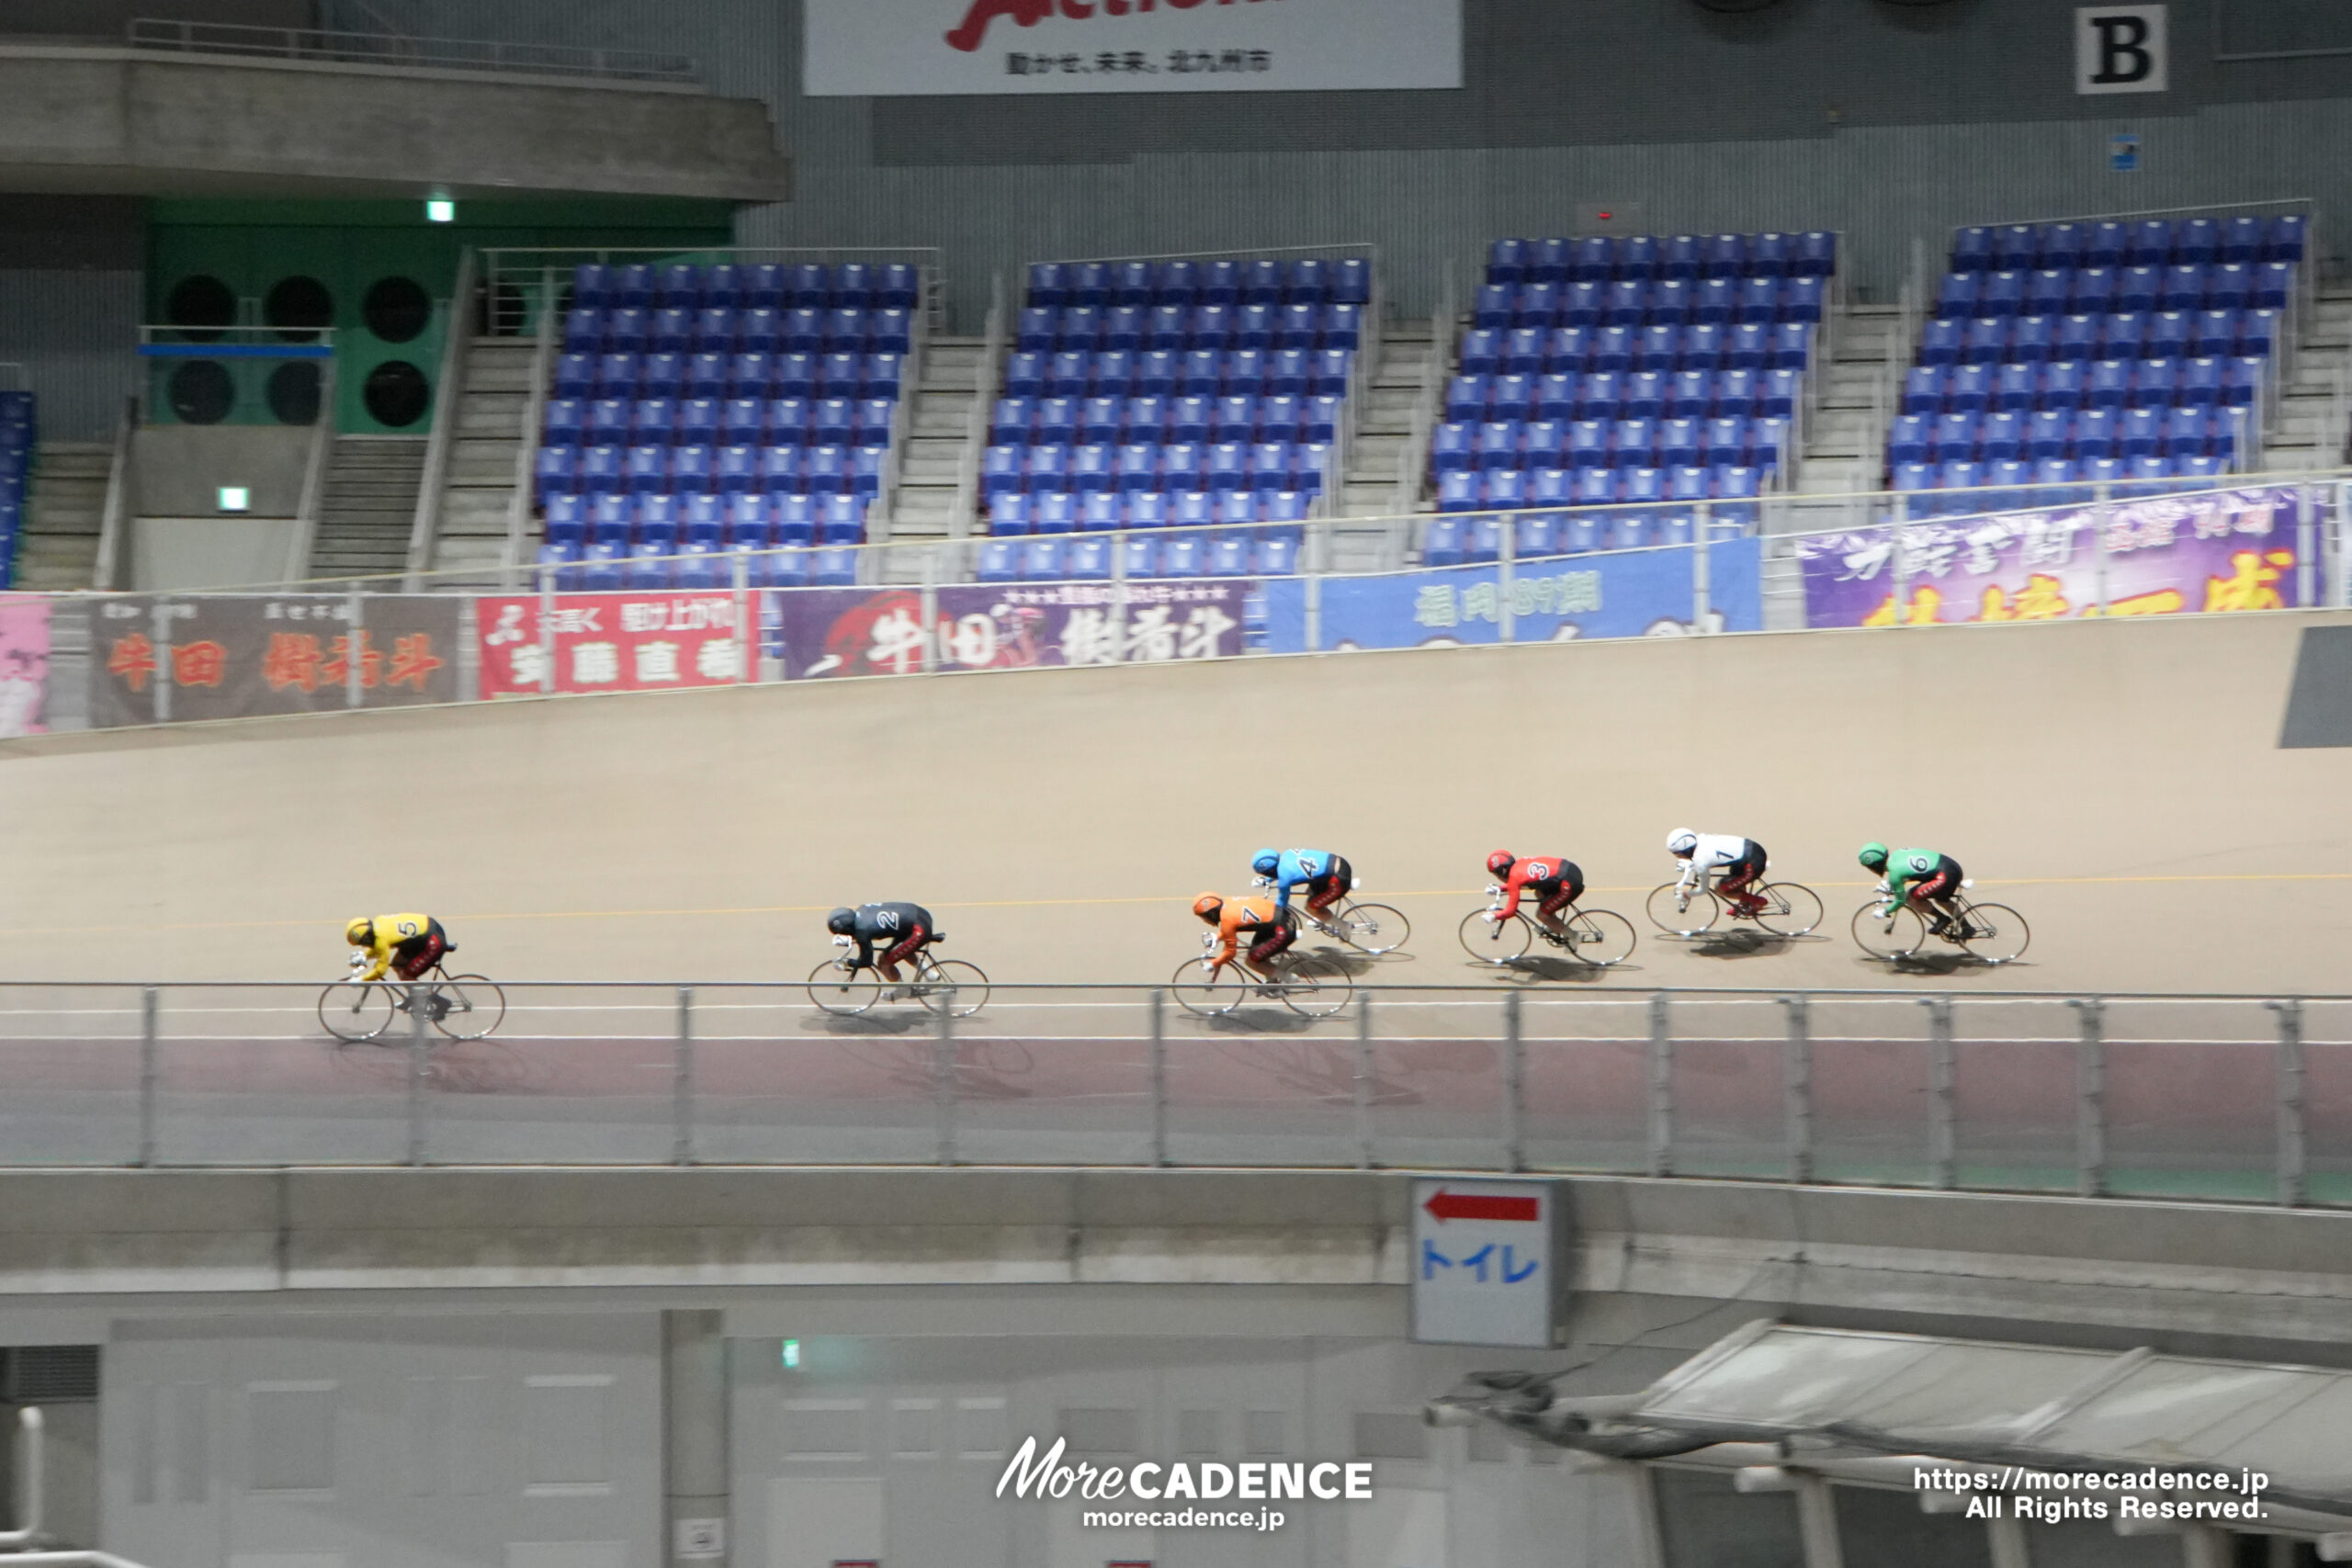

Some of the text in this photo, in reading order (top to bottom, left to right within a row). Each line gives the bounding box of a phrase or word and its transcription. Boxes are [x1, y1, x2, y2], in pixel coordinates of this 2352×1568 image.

[2089, 16, 2153, 84] B
[1296, 856, 1318, 879] 4
[1528, 862, 1550, 881] 3
[1909, 855, 1929, 873] 6
[876, 910, 899, 931] 2
[1242, 906, 1261, 924] 7
[397, 920, 418, 939] 5
[1421, 1238, 1539, 1283] トイレ
